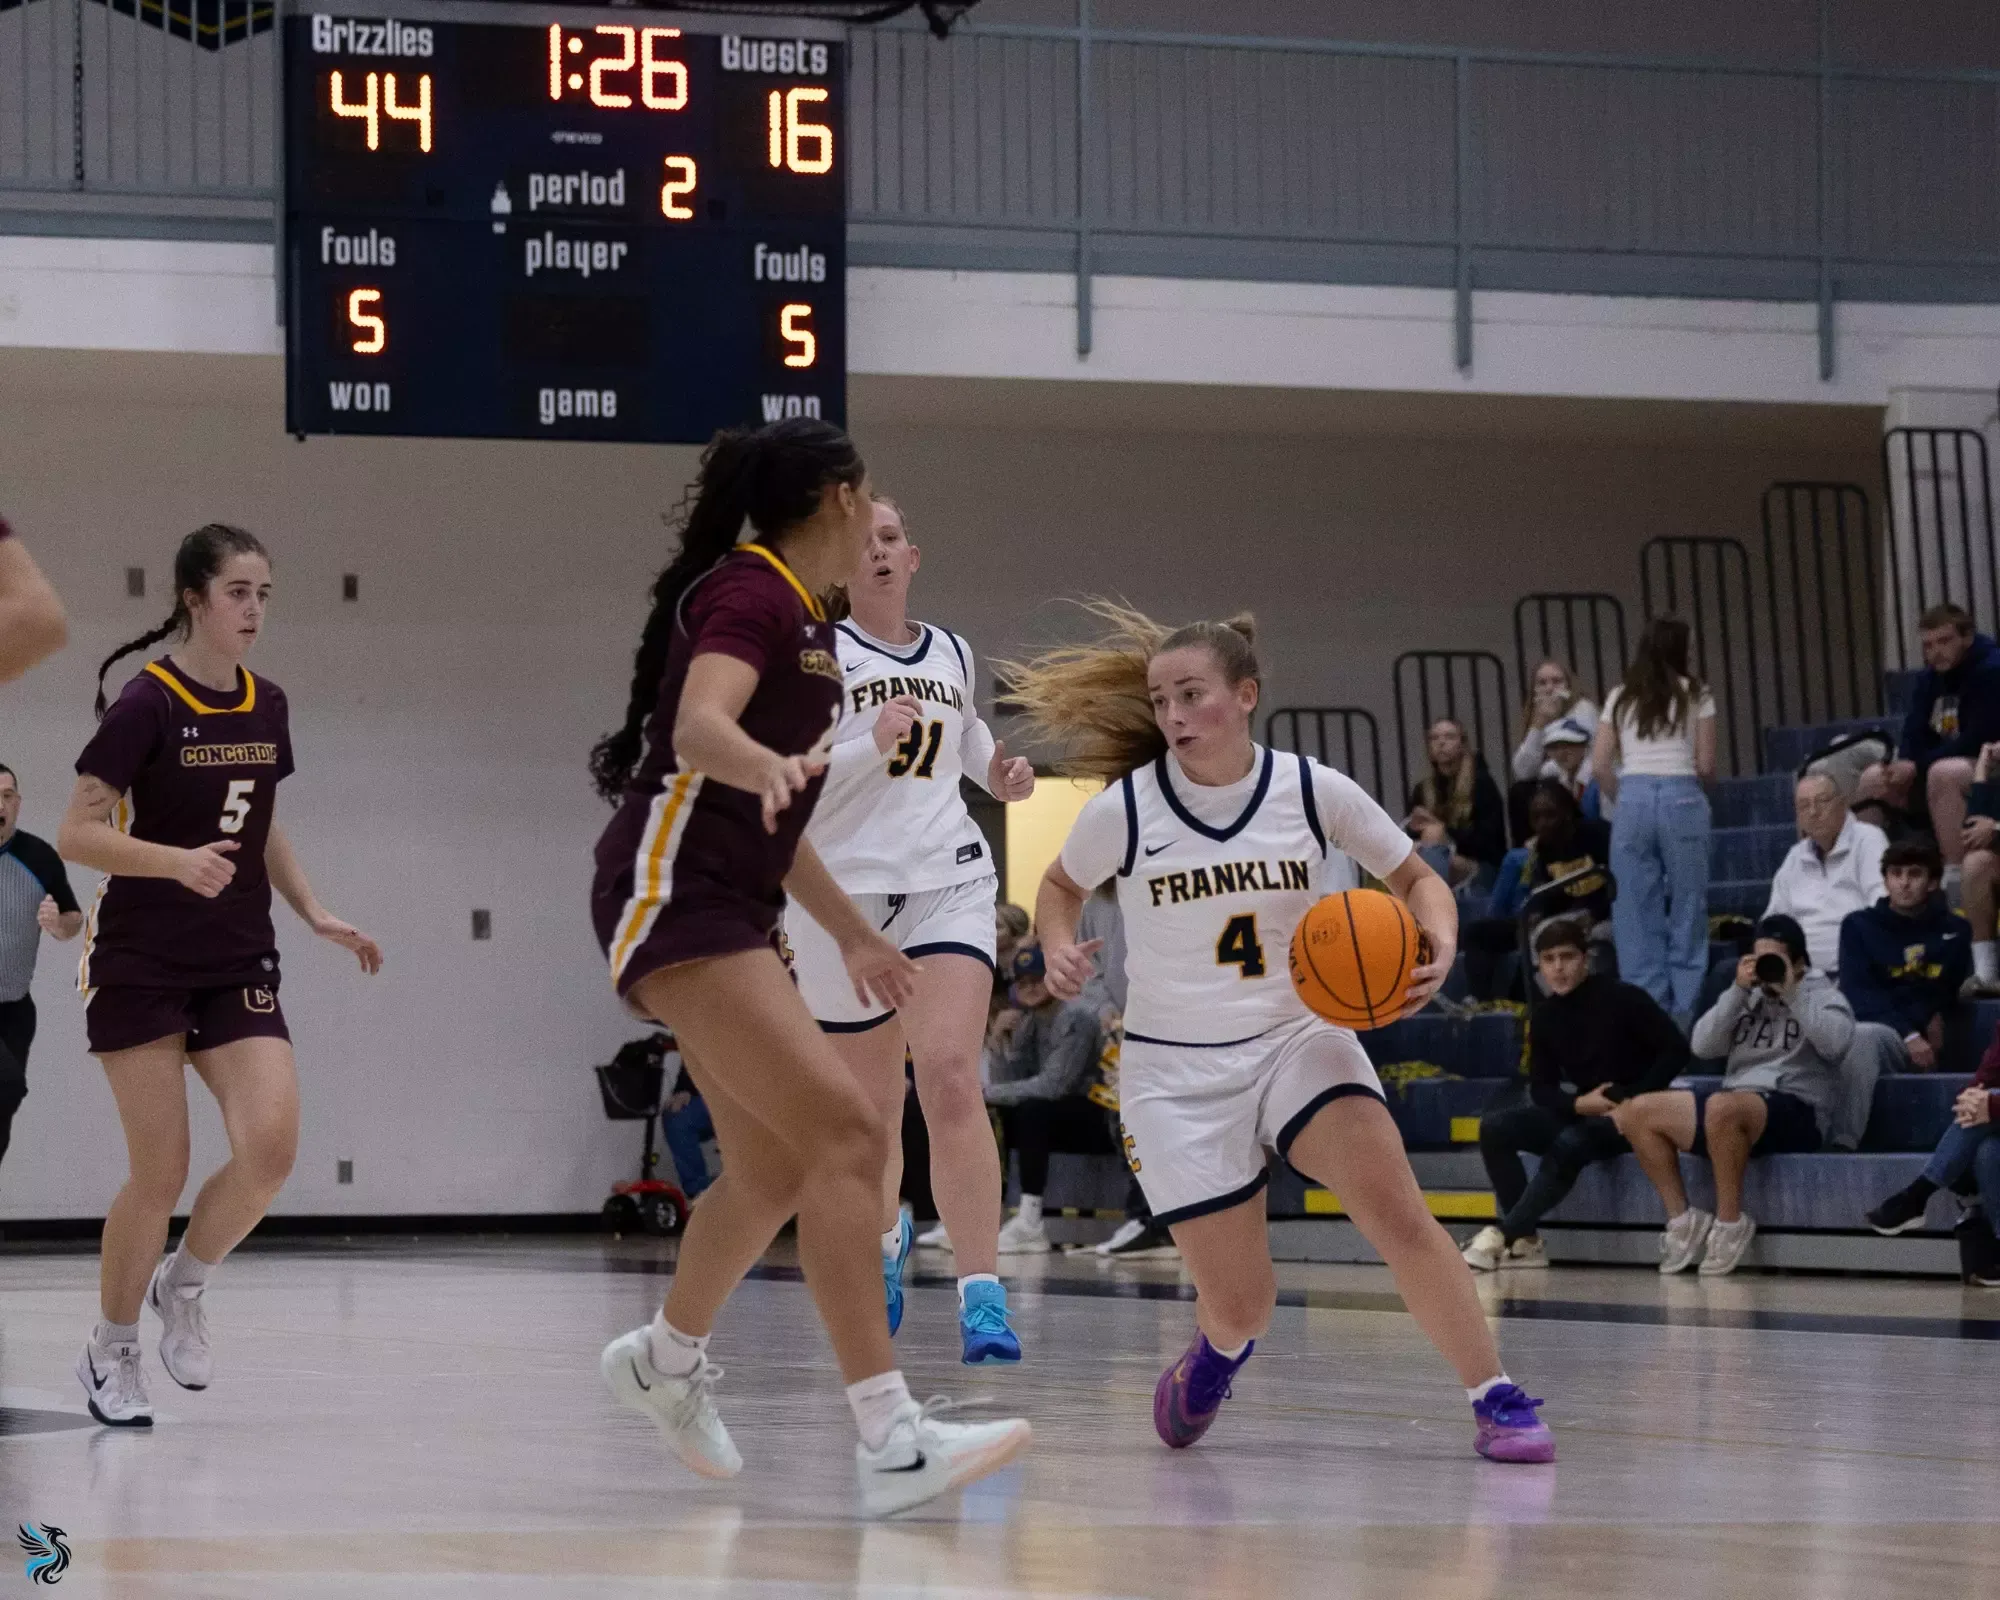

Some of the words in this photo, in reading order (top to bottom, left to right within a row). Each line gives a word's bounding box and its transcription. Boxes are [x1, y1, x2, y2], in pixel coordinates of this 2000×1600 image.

[312, 14, 433, 57] Grizzlies
[722, 35, 828, 75] Guests
[549, 23, 688, 111] 1:26
[330, 70, 433, 153] 44
[768, 87, 834, 174] 16
[529, 169, 625, 210] period
[661, 155, 697, 220] 2
[320, 227, 396, 266] fouls
[525, 231, 628, 277] player
[754, 243, 827, 282] fouls
[330, 381, 391, 412] won
[538, 388, 617, 425] game
[761, 393, 821, 422] won
[219, 779, 255, 833] 5
[1148, 859, 1310, 907] FRANKLIN
[1215, 911, 1266, 980] 4
